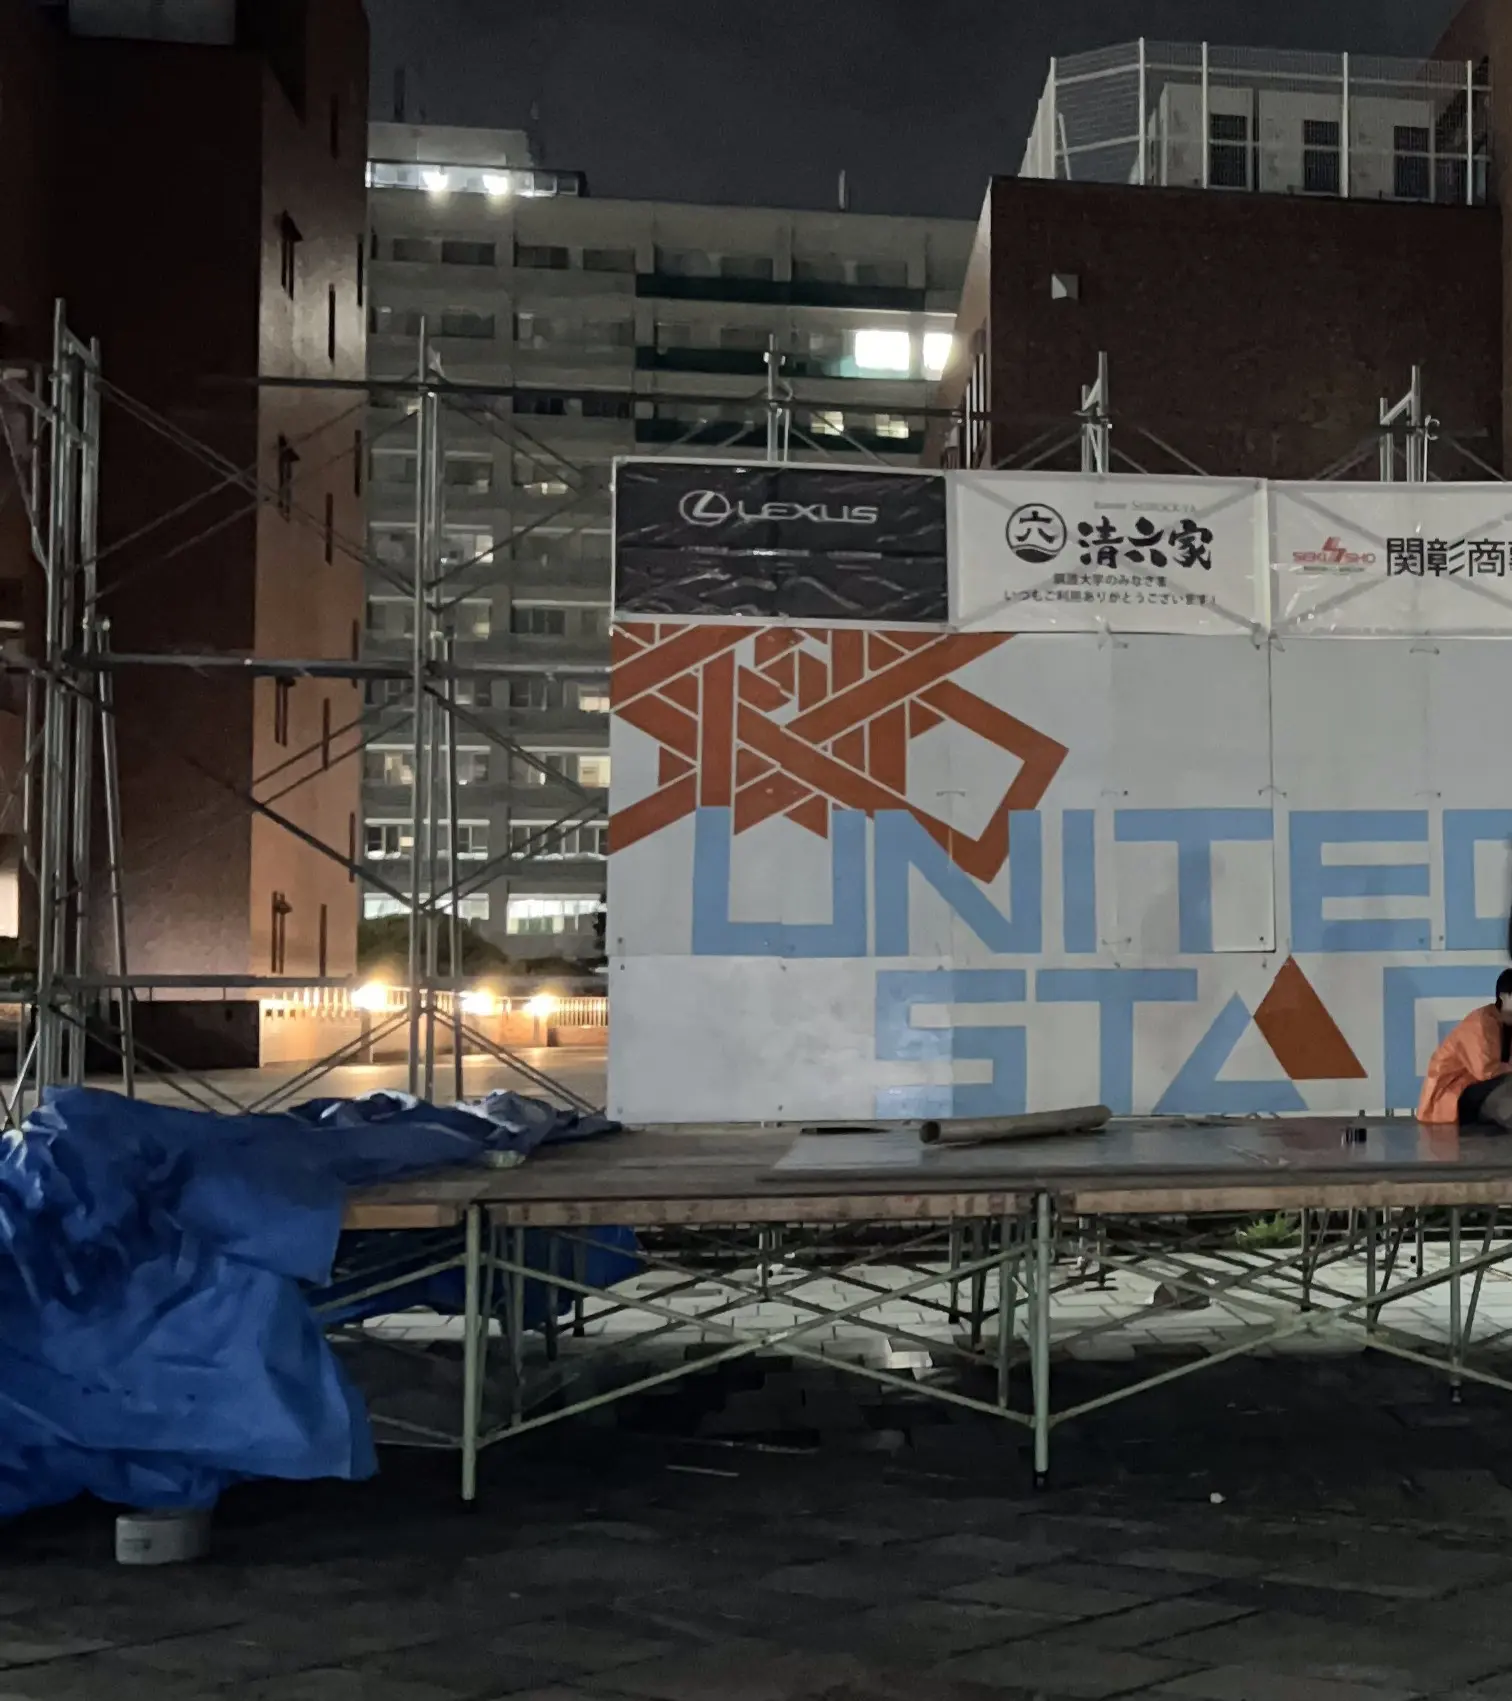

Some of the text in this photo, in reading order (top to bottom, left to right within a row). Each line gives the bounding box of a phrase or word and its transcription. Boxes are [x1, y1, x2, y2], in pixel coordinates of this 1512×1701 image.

[738, 500, 878, 524] LEXUS
[1077, 516, 1214, 571] 清六家
